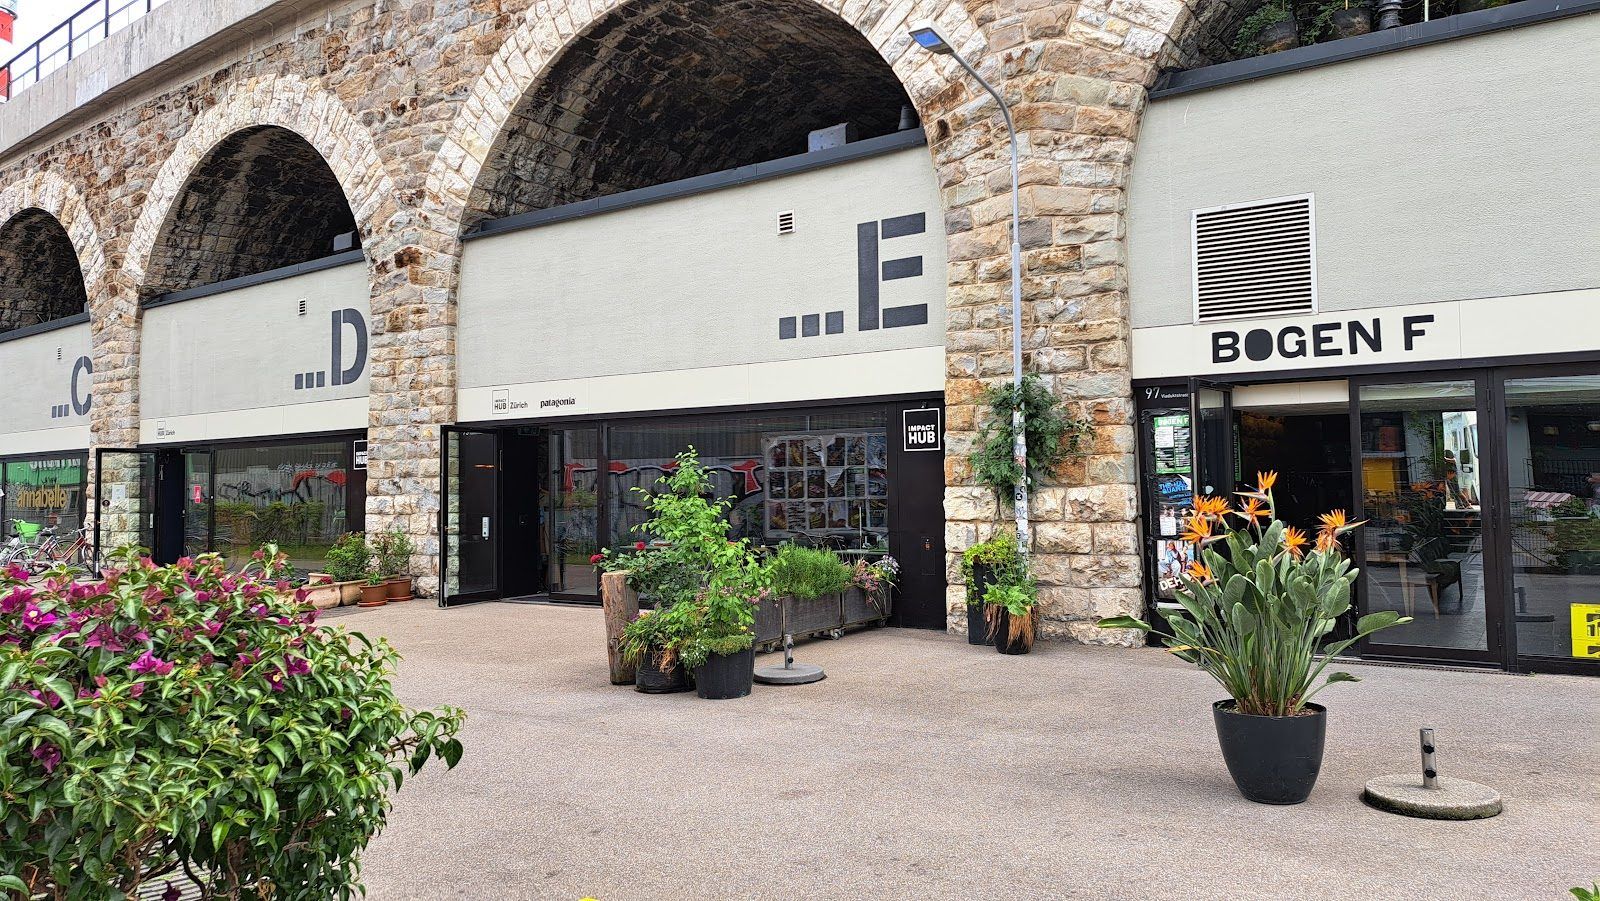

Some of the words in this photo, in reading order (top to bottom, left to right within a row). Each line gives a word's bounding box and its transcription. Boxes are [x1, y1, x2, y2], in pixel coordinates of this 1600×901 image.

[1212, 318, 1382, 363] BOGEN
[1403, 314, 1434, 350] F
[1145, 387, 1160, 400] 97
[494, 402, 507, 410] HUB
[540, 397, 576, 408] patagonia
[907, 424, 936, 432] IMPACT
[908, 431, 936, 445] HUB
[17, 484, 67, 508] annabelle
